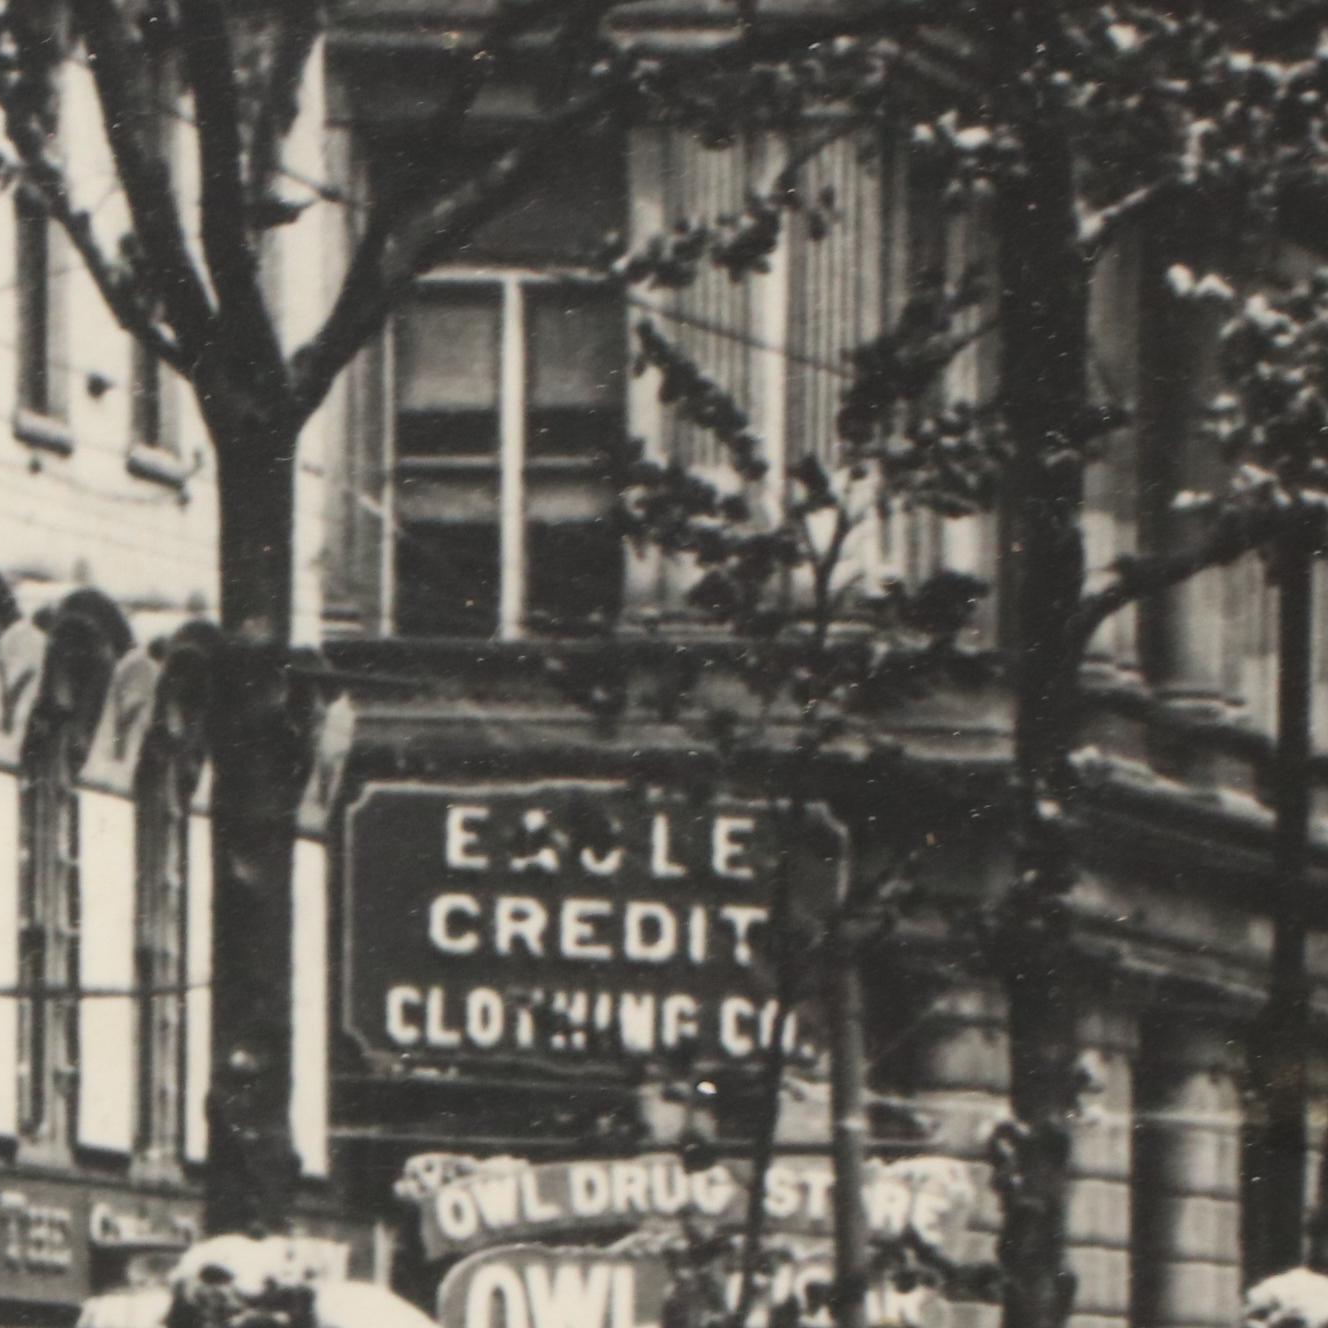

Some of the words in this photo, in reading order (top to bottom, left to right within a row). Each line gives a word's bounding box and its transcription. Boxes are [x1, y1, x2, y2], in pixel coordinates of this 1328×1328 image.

[427, 894, 770, 966] CREDIT
[436, 1158, 562, 1240] OWL
[568, 1155, 737, 1217] DRUG
[763, 1164, 952, 1248] STRE
